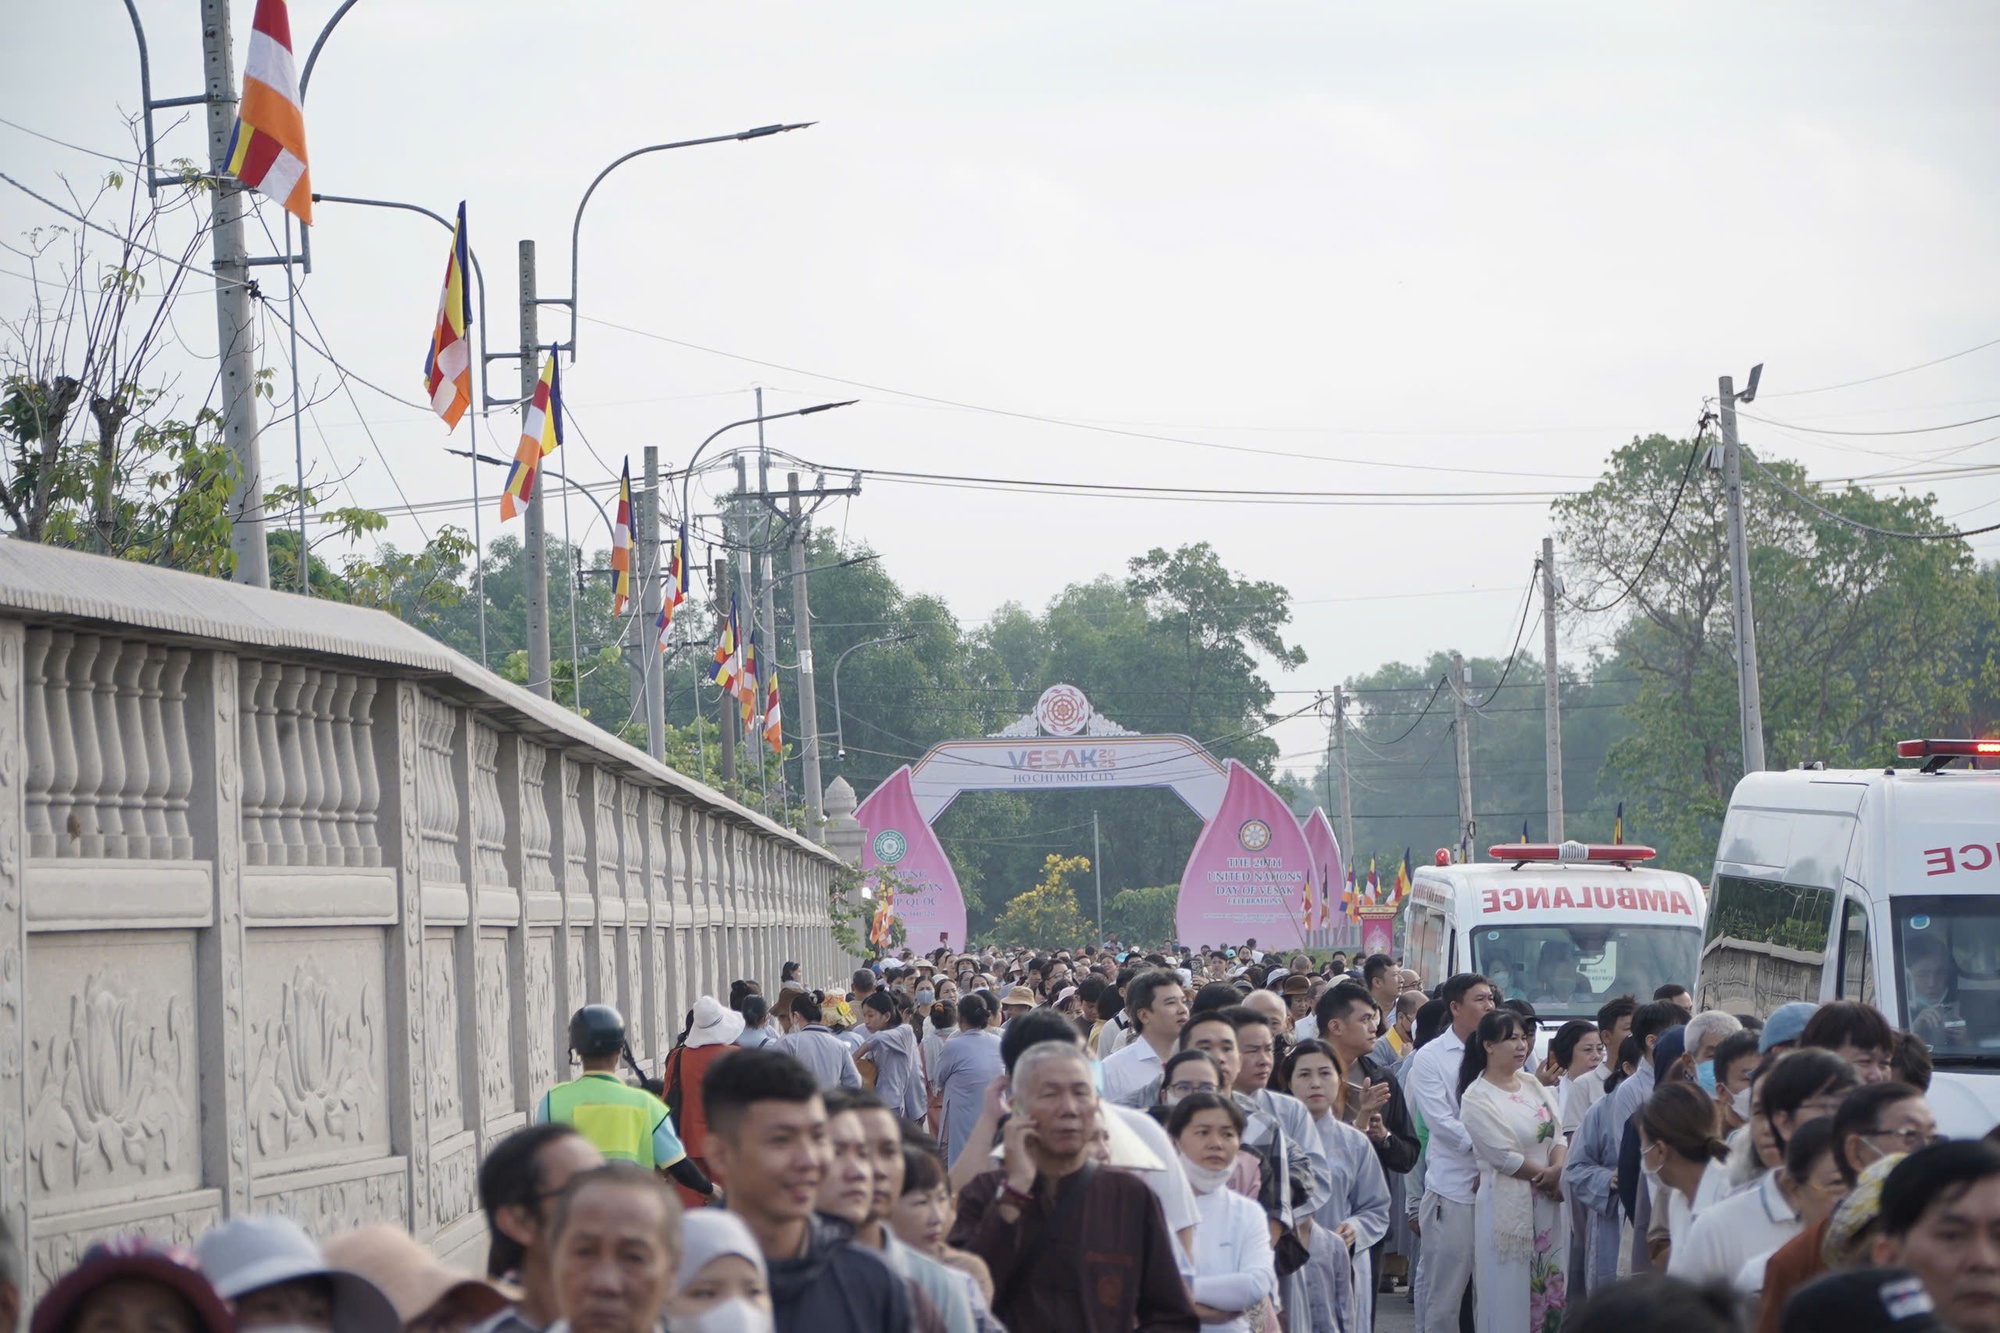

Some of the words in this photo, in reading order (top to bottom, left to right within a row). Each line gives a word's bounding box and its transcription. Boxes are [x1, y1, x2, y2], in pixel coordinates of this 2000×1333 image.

[1007, 749, 1098, 770] VESAK
[1099, 749, 1116, 758] 20
[1056, 772, 1088, 782] MINH
[1091, 772, 1116, 781] CITY
[1228, 857, 1250, 868] THE
[1254, 857, 1282, 868] 20TH
[1208, 871, 1250, 881] UNITED
[1254, 871, 1302, 881] NATIONS
[1215, 885, 1238, 895] DAY
[1242, 885, 1256, 895] OF
[1259, 885, 1294, 895] VESAK
